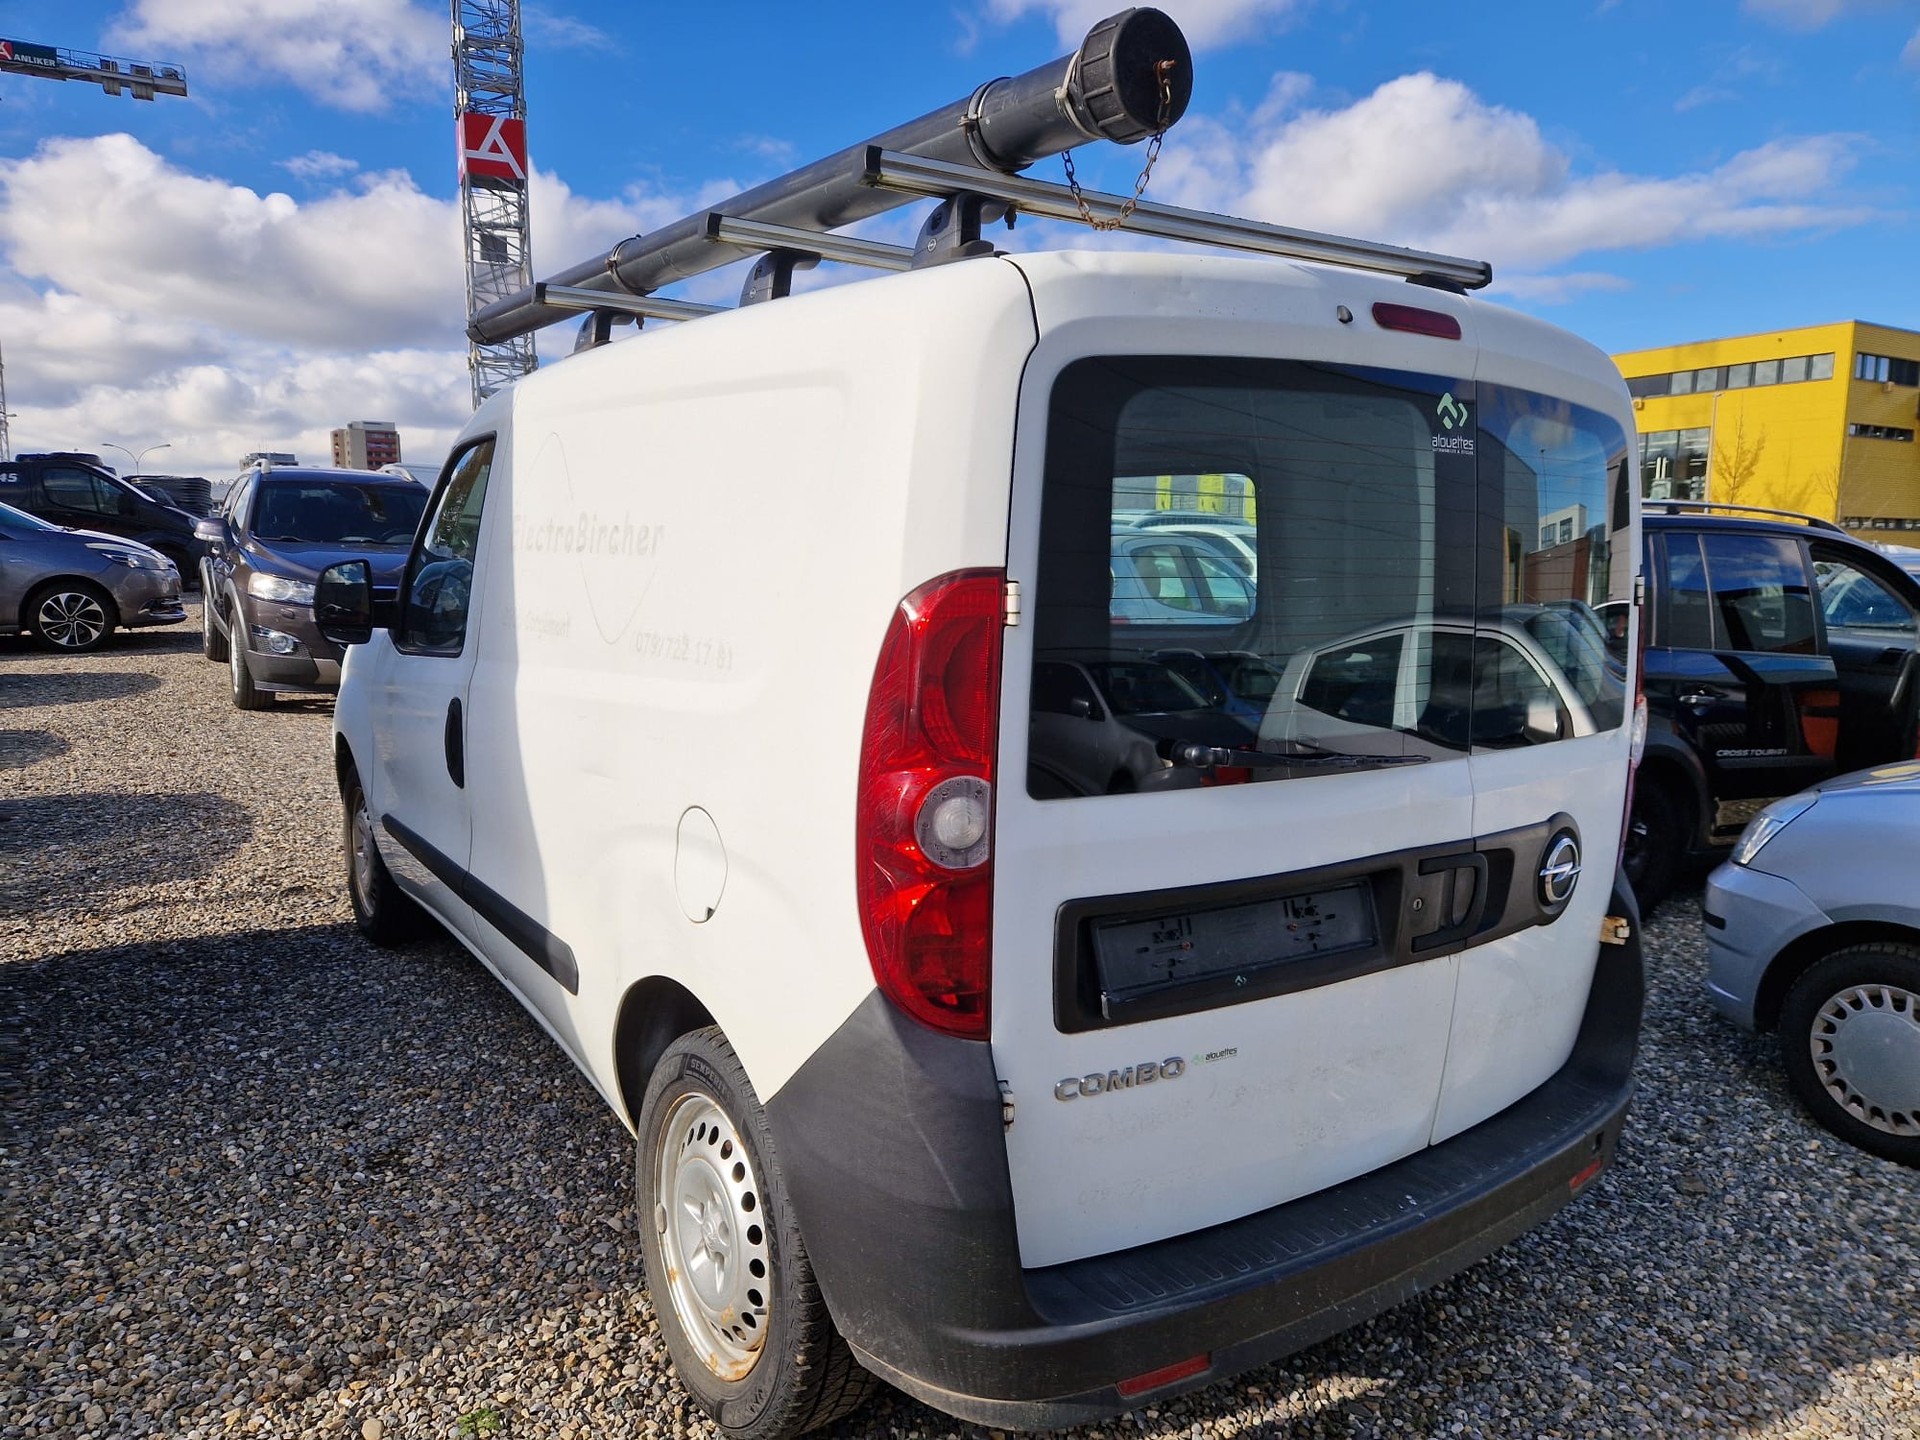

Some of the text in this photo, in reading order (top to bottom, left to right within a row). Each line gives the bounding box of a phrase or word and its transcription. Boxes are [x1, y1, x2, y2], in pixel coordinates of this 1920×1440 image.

[13, 53, 56, 67] ANLIKER
[1431, 433, 1474, 450] alouettes
[1054, 1056, 1186, 1101] COMBO
